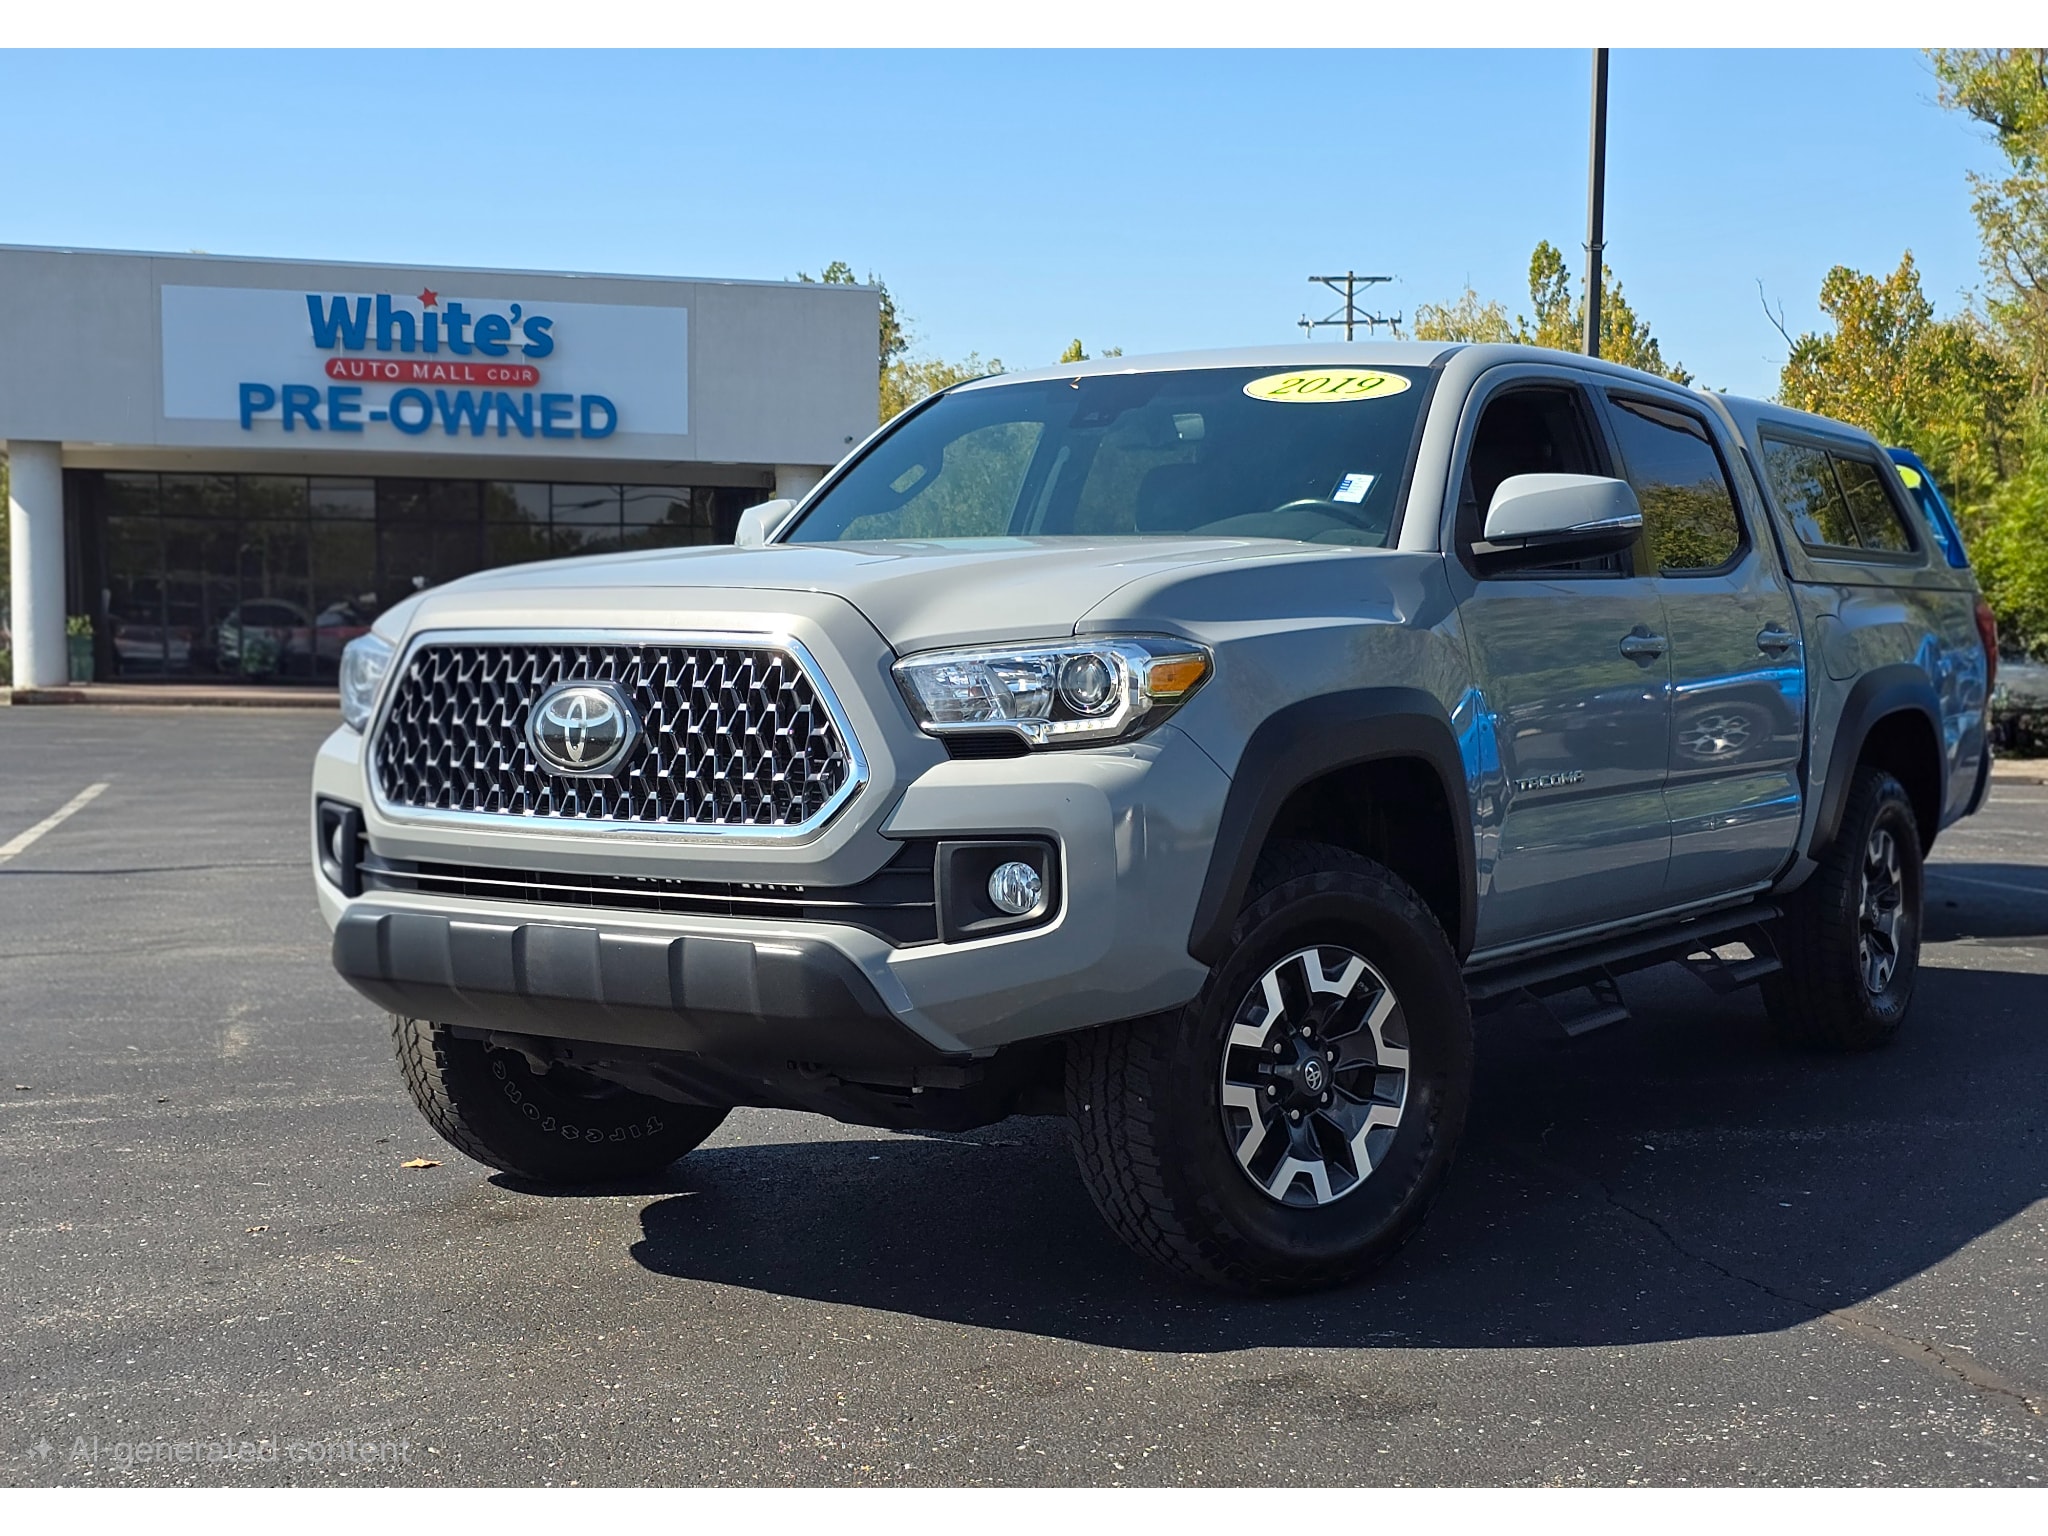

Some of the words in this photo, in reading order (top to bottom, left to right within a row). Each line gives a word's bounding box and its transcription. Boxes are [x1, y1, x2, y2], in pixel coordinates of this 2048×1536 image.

[306, 288, 555, 358] White's
[331, 359, 401, 379] AUTO
[412, 364, 476, 382] MALL
[486, 368, 534, 382] CDJR
[1268, 377, 1385, 395] 2019
[238, 382, 619, 440] PRE-OWNED
[1514, 770, 1584, 790] TACOMA
